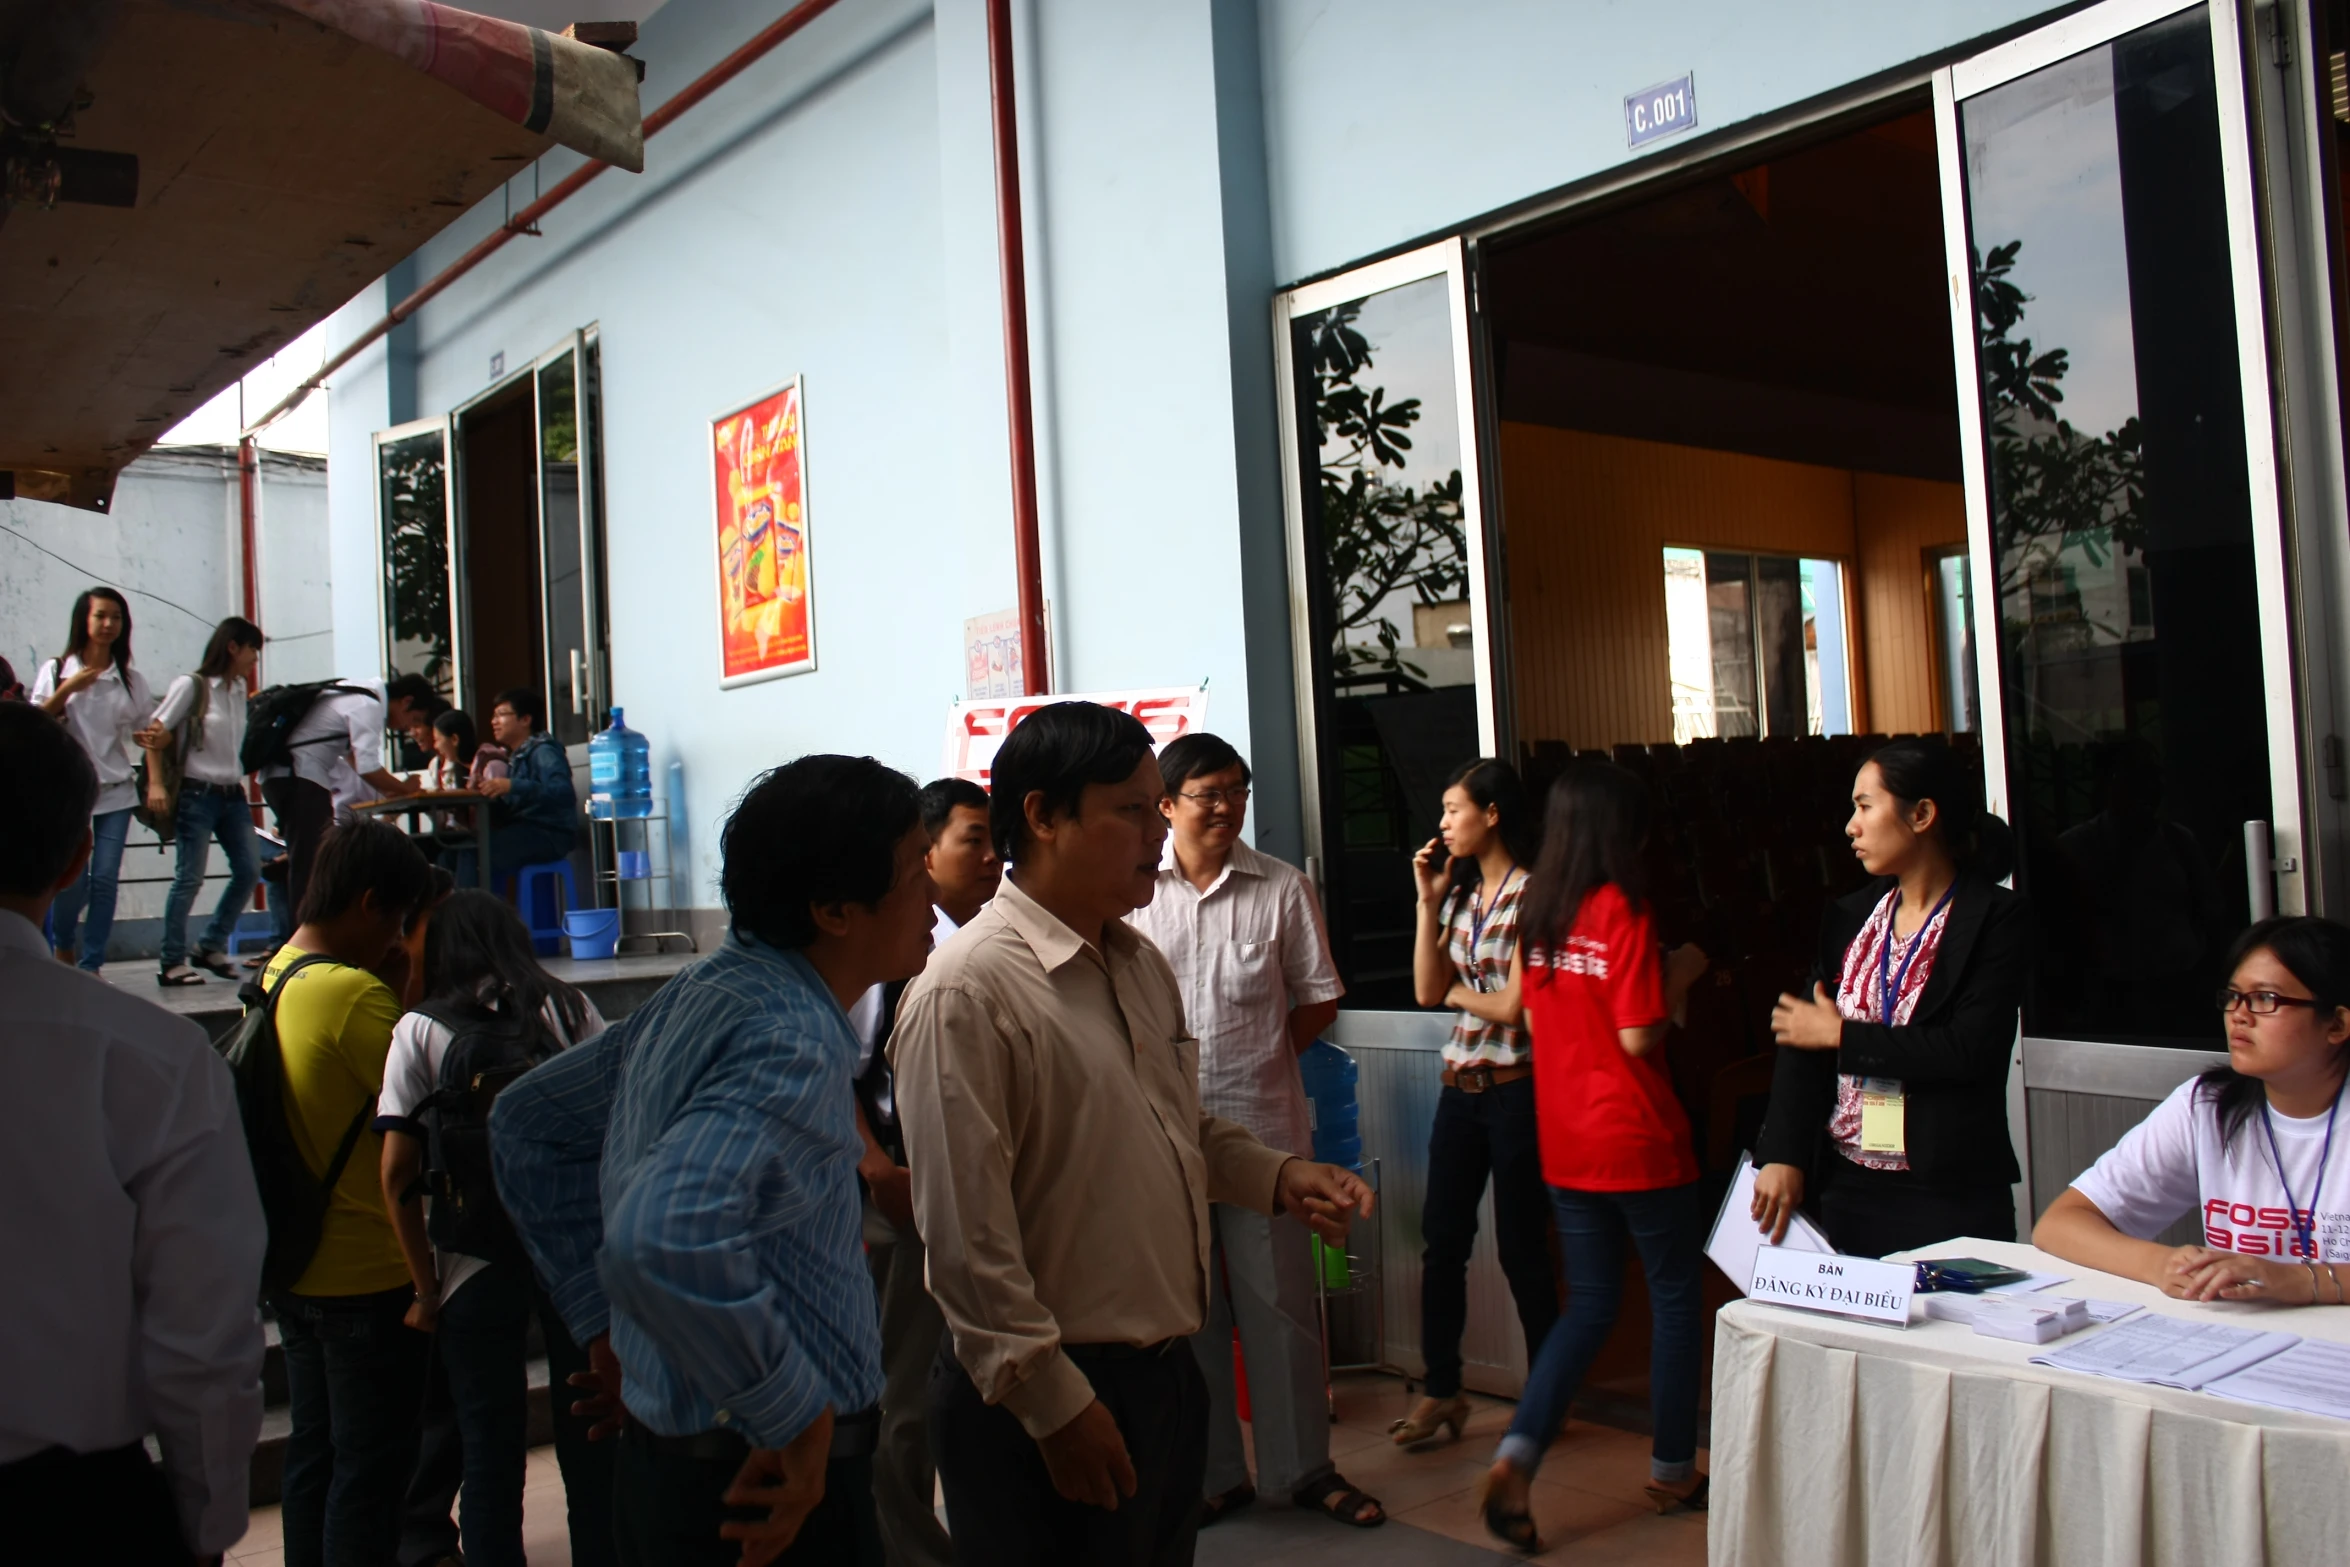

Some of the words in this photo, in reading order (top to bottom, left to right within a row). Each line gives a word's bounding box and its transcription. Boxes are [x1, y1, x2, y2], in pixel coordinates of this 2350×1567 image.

[1634, 88, 1685, 133] C.001
[2321, 1224, 2350, 1234] 11-12
[1817, 1261, 1844, 1277] BÀN
[1755, 1275, 1802, 1296] ĐĂNG
[1805, 1282, 1828, 1300] KÝ
[1830, 1287, 1861, 1306] ĐẠI
[1863, 1288, 1903, 1311] BIỂU
